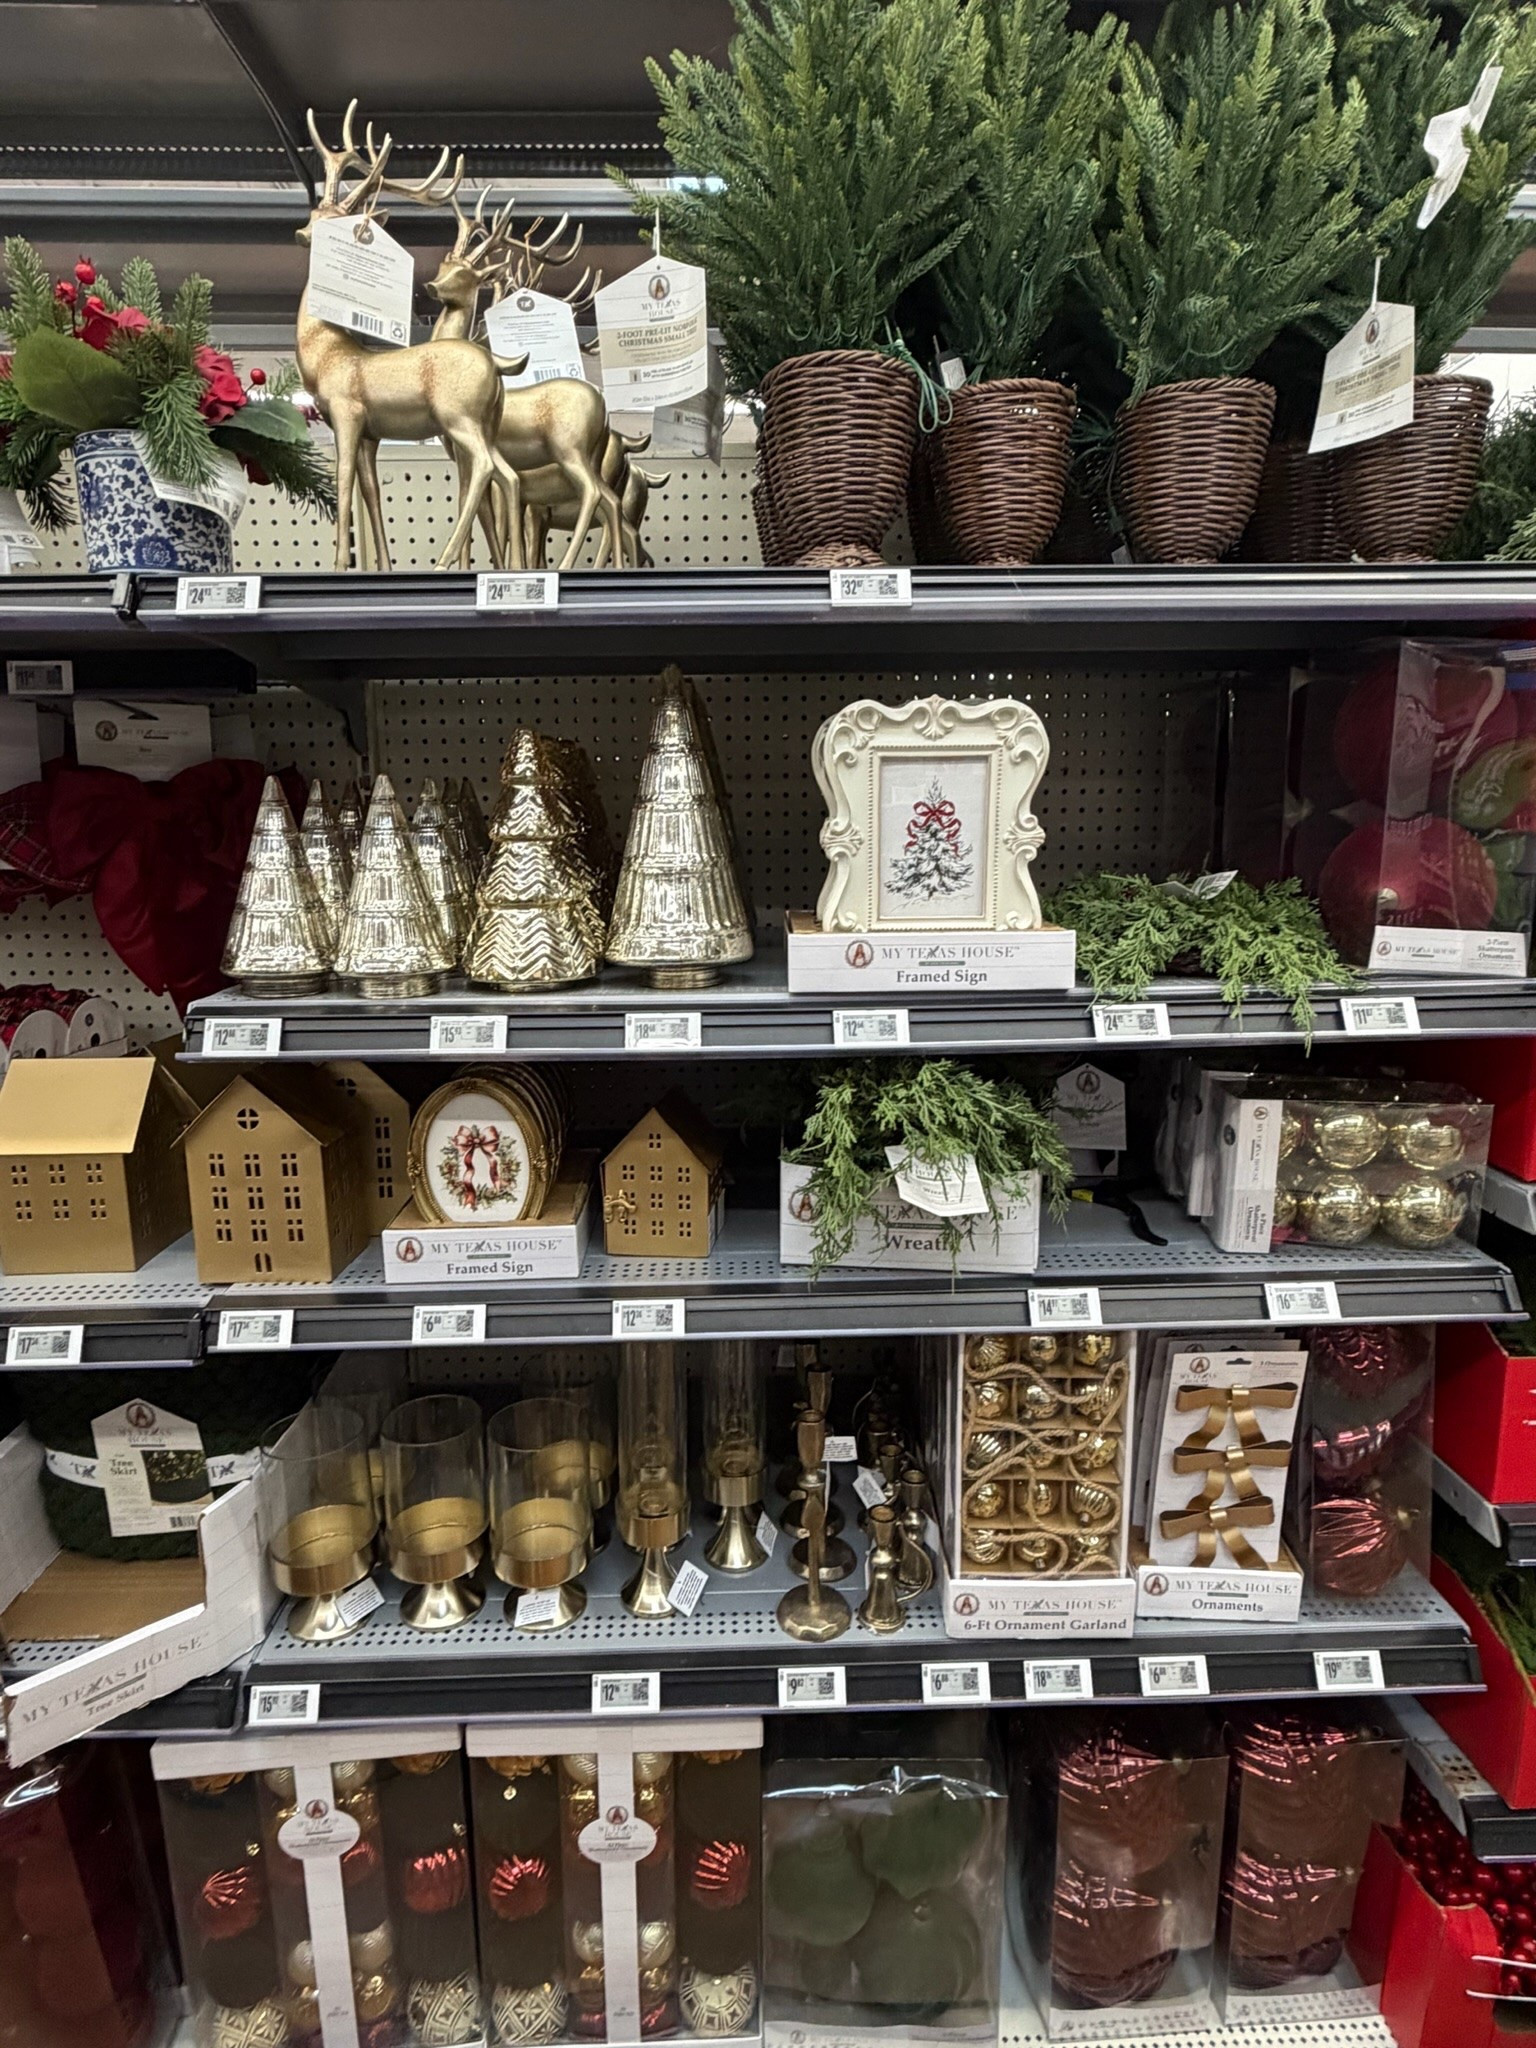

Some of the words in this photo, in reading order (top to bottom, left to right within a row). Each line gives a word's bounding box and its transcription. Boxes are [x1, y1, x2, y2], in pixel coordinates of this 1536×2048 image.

[618, 338, 663, 347] CHRISTMAS
[881, 947, 902, 959] MY
[907, 945, 956, 960] TEXAS
[896, 969, 950, 983] Framed
[954, 969, 987, 986] Sign
[431, 1242, 450, 1254] MY
[455, 1240, 502, 1253] TEXAS
[446, 1262, 498, 1275] Framed
[502, 1261, 533, 1276] Sign
[1176, 1580, 1194, 1591] MY
[1197, 1580, 1241, 1591] TEXAS
[988, 1600, 1007, 1611] MY
[1012, 1598, 1060, 1610] TEXAS
[1191, 1598, 1264, 1612] Ornaments
[963, 1619, 991, 1631] 6-Ft
[994, 1619, 1066, 1630] Ornament
[1070, 1618, 1127, 1630] Garland
[21, 1704, 49, 1723] MY
[59, 1670, 127, 1708] TEXAS
[86, 1700, 115, 1717] Tree
[116, 1684, 146, 1706] Skirt
